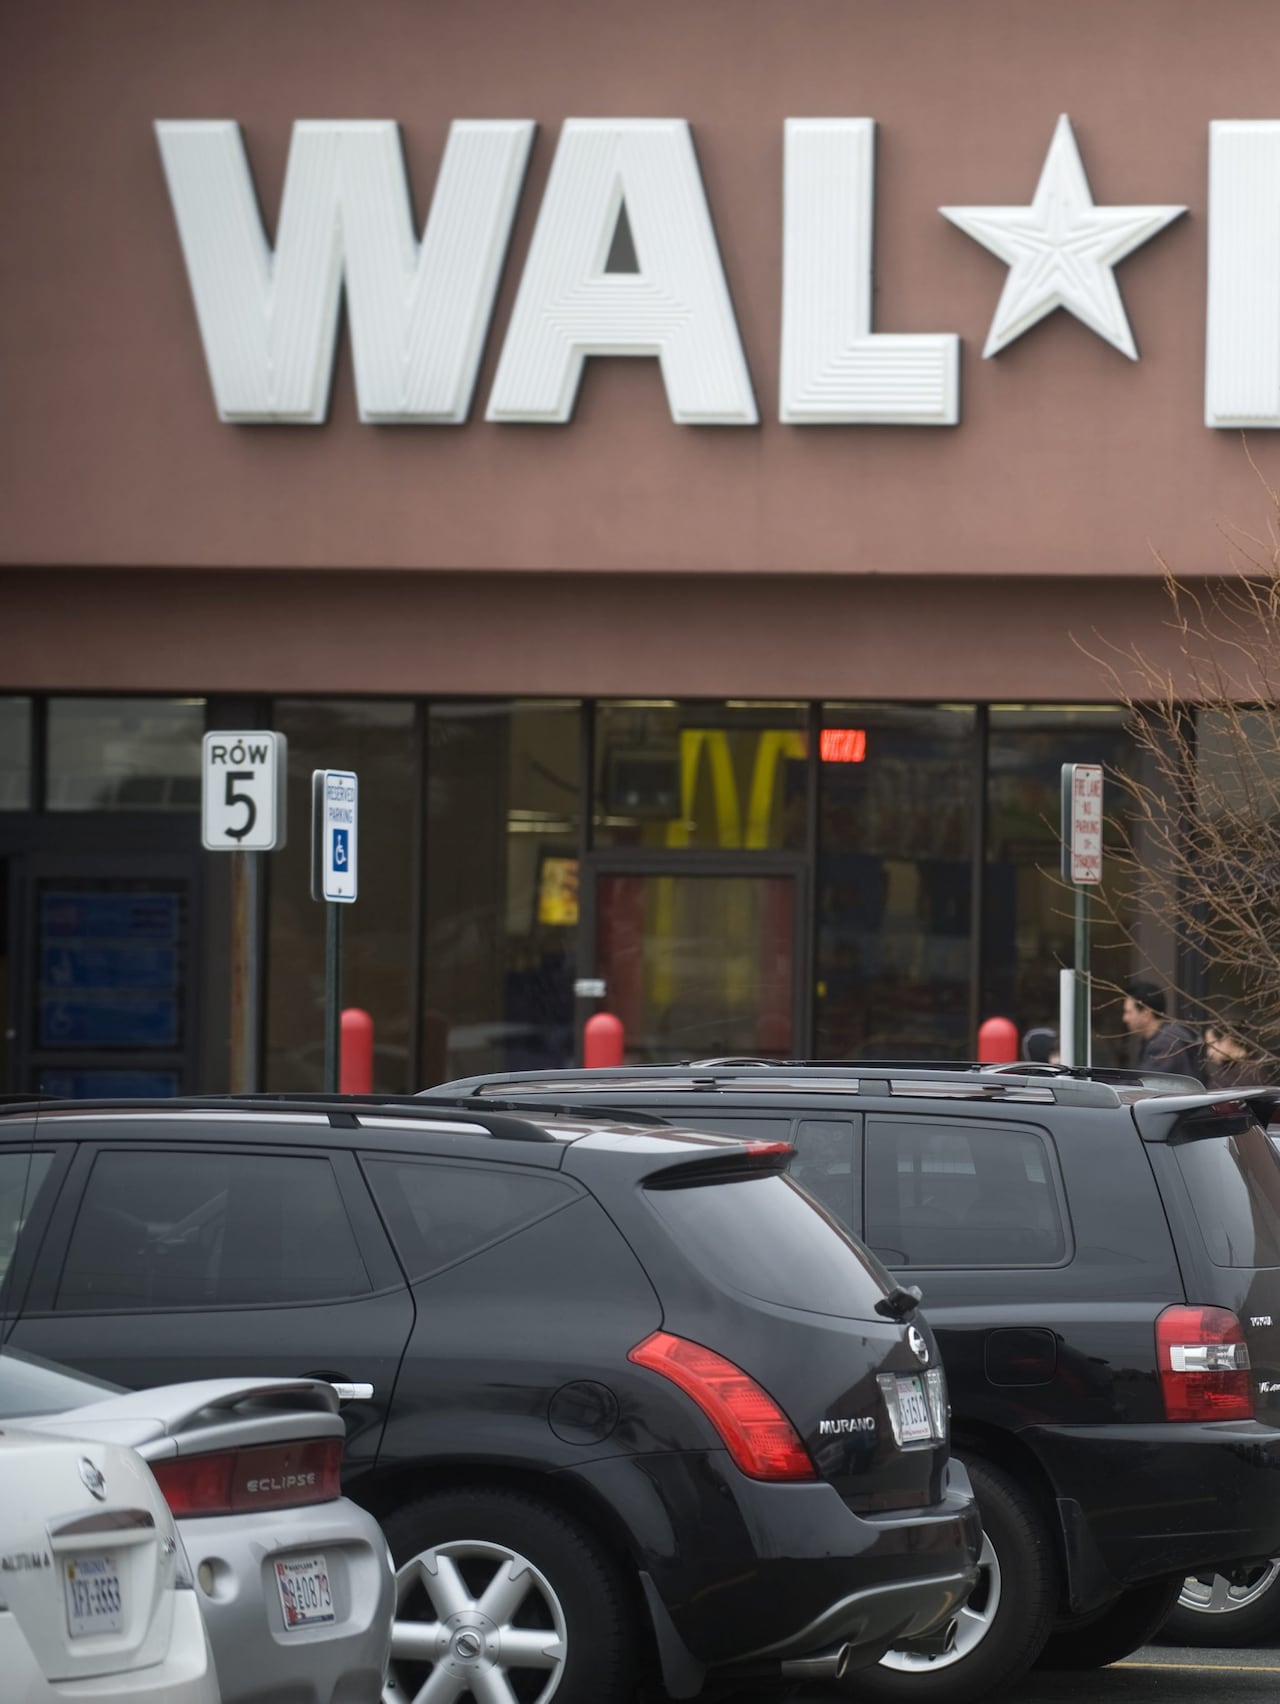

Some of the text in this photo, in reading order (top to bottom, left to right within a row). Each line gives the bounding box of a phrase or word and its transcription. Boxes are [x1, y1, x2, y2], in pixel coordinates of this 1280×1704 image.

[153, 117, 959, 426] WAL
[211, 745, 268, 765] ROW
[224, 771, 257, 838] 5
[327, 786, 355, 803] RESERVED
[329, 806, 353, 824] PARKING
[820, 1416, 875, 1434] MURANO
[247, 1472, 315, 1492] ECLIPSE
